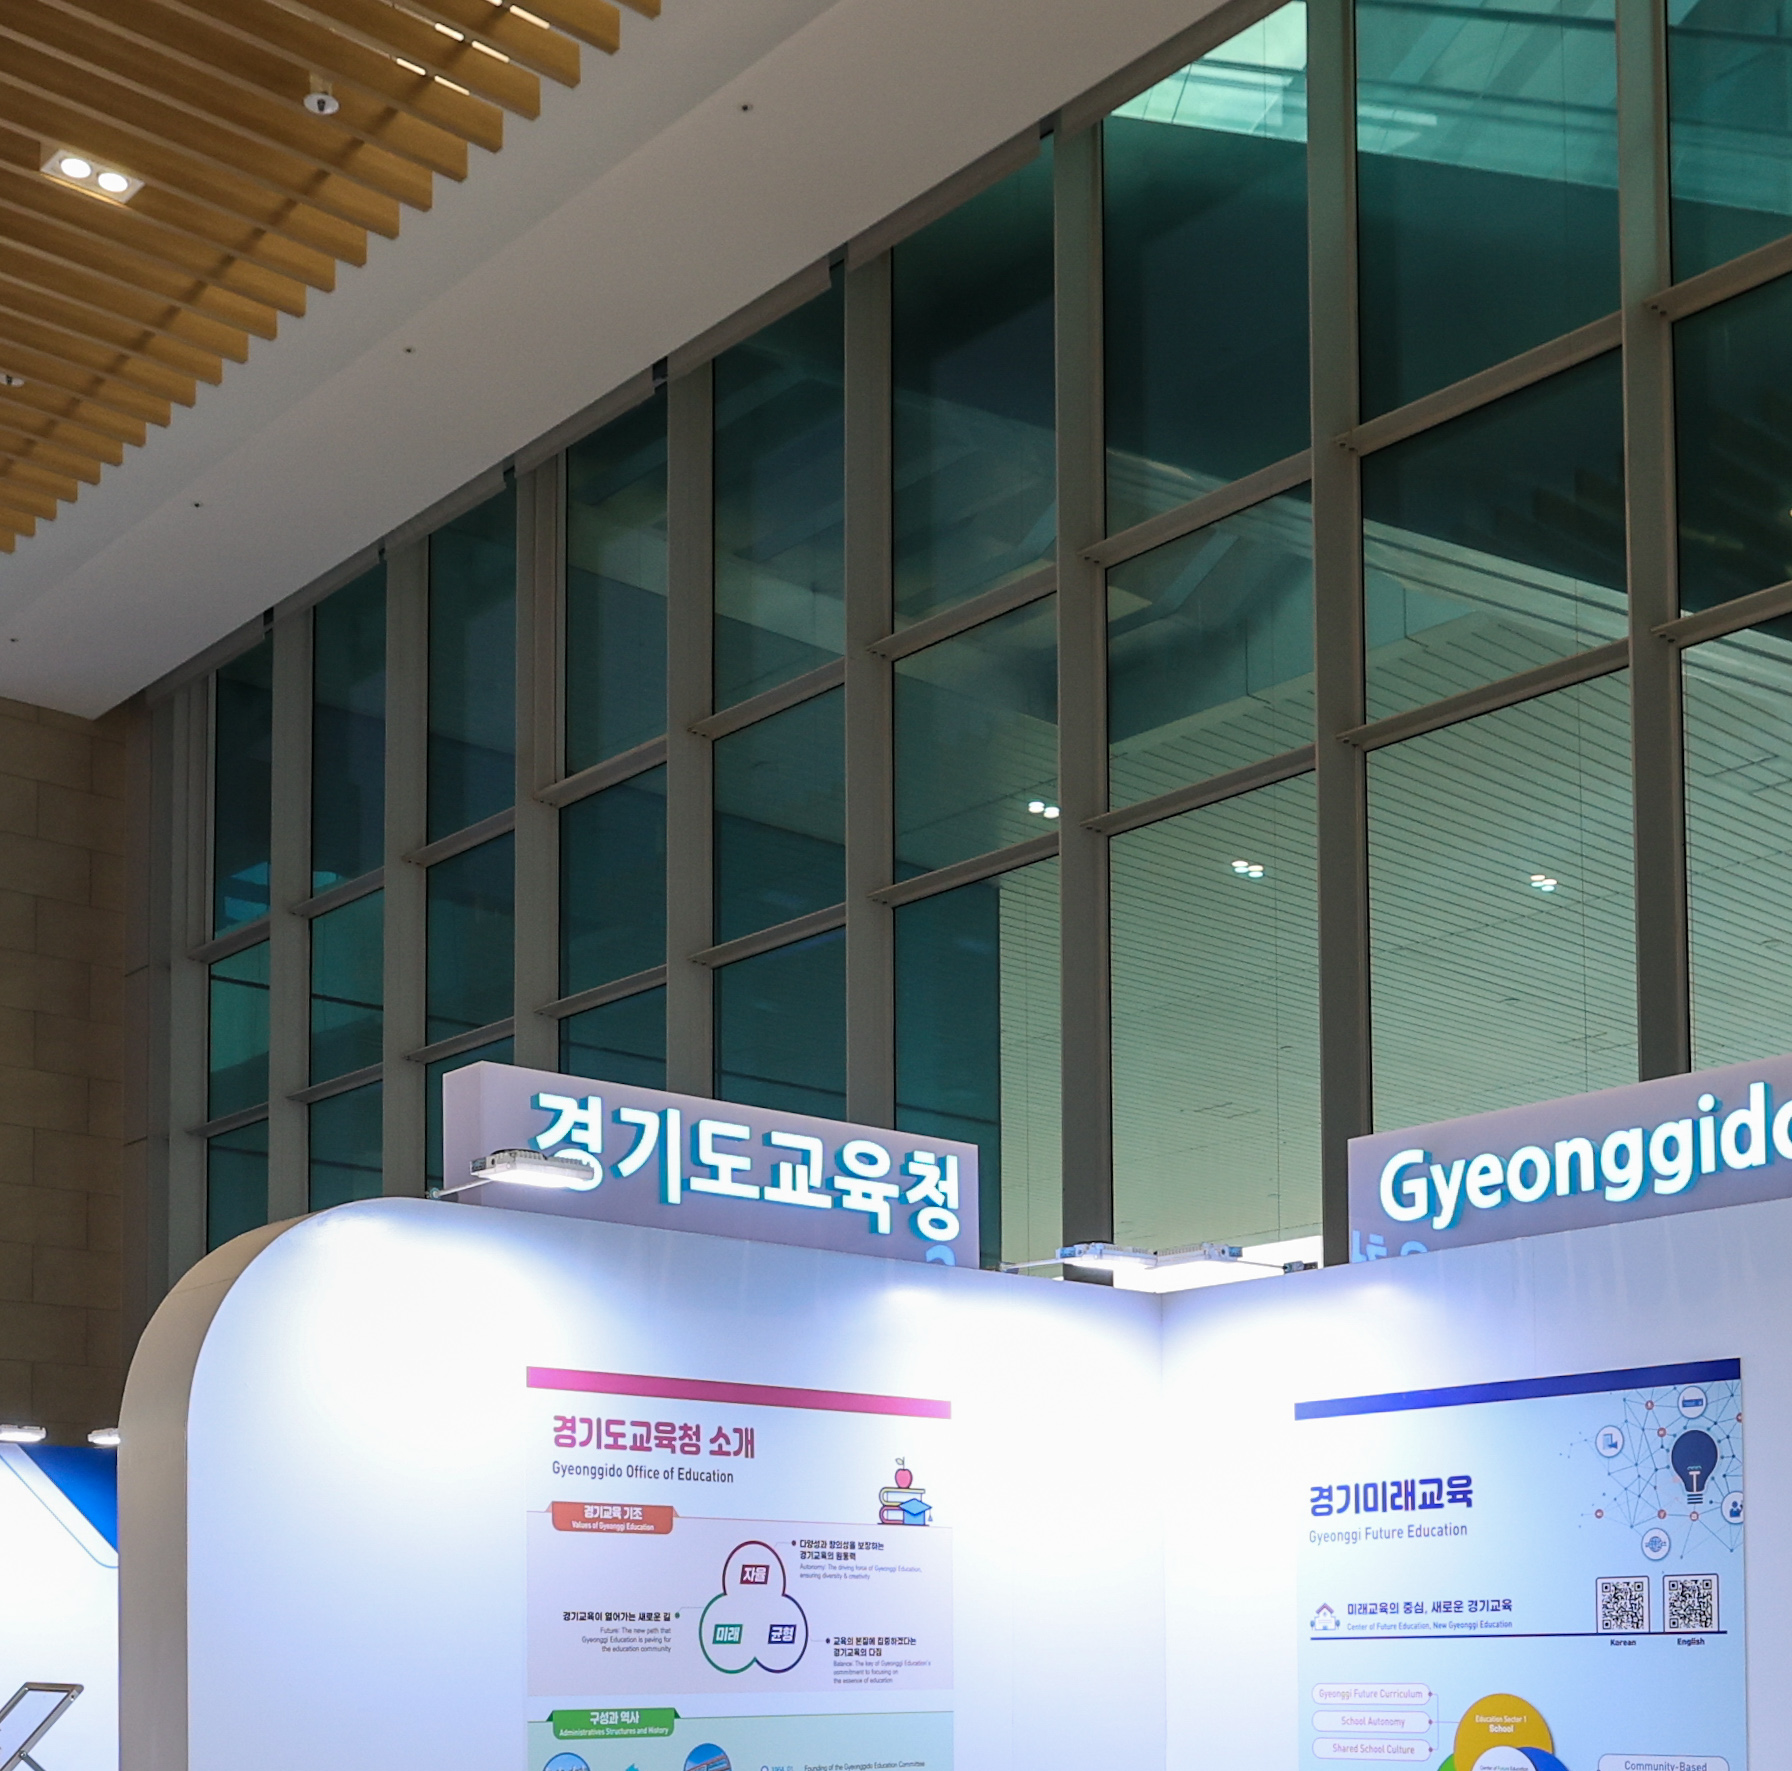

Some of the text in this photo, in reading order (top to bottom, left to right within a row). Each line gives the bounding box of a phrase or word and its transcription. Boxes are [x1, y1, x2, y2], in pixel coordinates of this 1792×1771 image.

[531, 1092, 961, 1243] 경기도교육청
[553, 1416, 755, 1459] 경기도교육청 소개
[552, 1460, 734, 1483] Gyeonggido Office of Education
[1310, 1475, 1473, 1516] 경기미래교육
[1309, 1522, 1468, 1545] Gyeonggi Future Education
[744, 1566, 766, 1583] 자율
[1347, 1598, 1512, 1615] 미래교육의 중심, 새로운 경기교육
[716, 1626, 740, 1643] 미래
